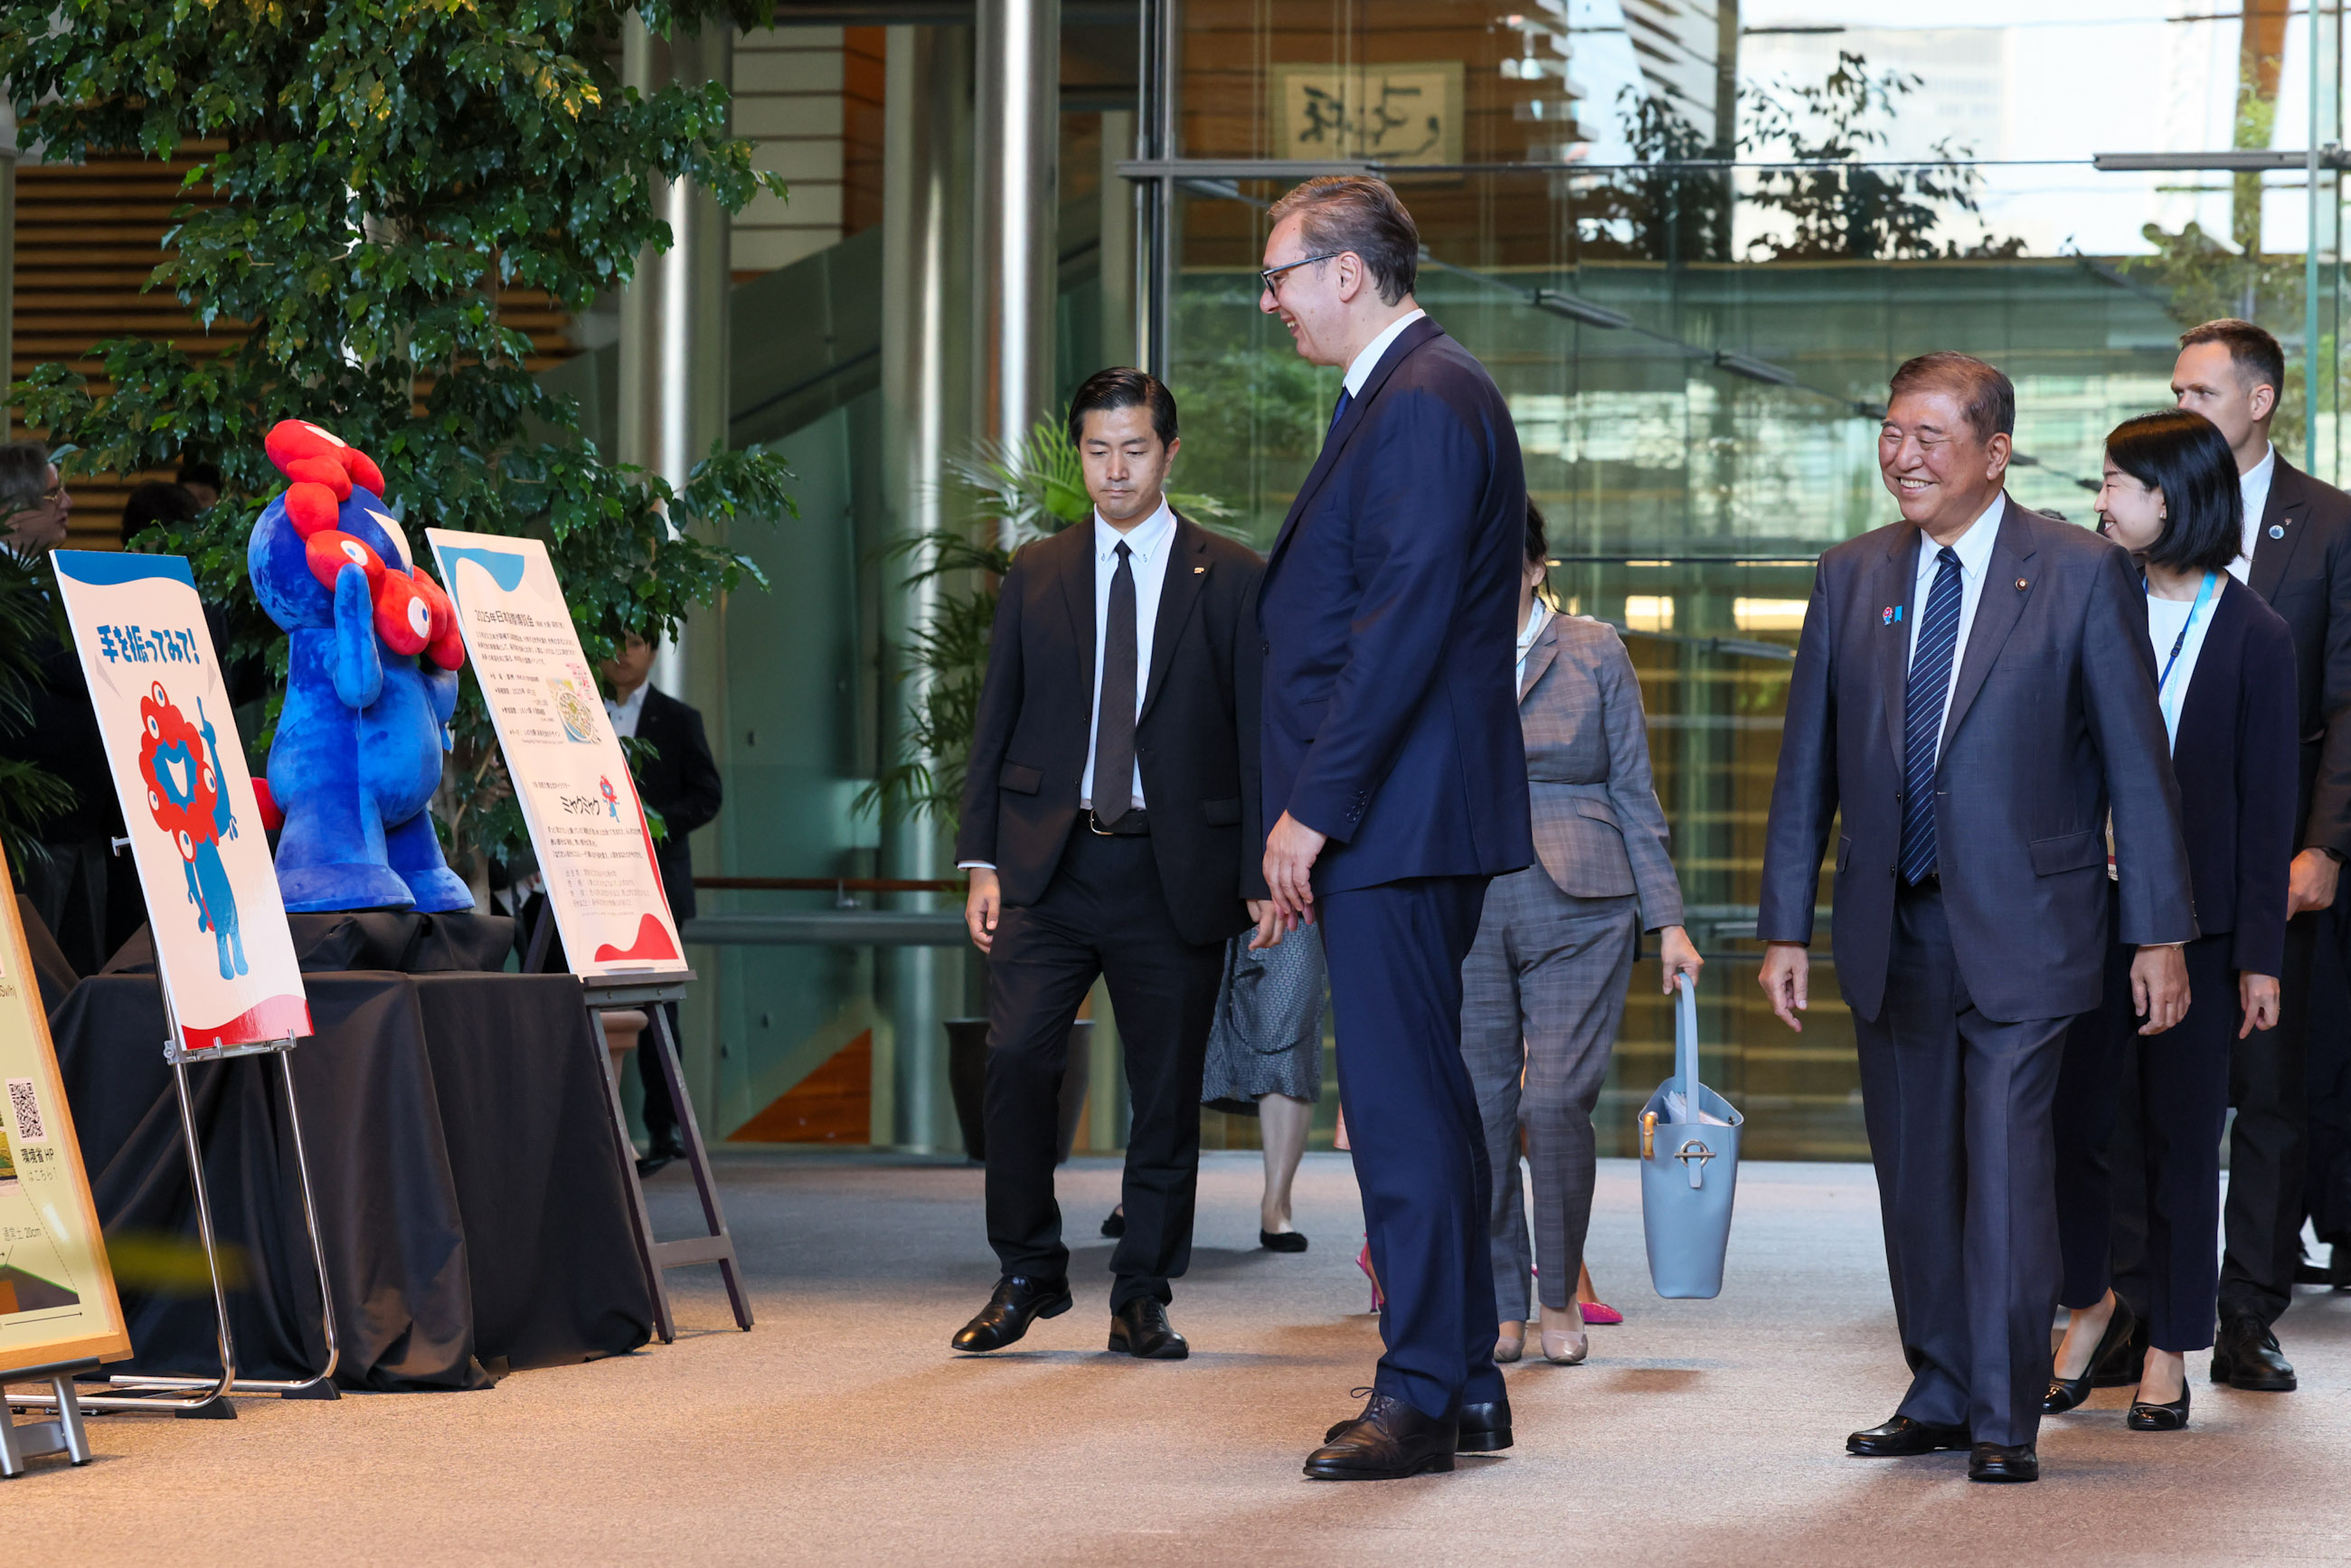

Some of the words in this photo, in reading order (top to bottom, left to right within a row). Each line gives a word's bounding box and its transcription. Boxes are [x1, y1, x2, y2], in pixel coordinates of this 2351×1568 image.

[560, 796, 600, 816] ミャクミャク
[20, 1147, 44, 1164] 環境省
[44, 1148, 54, 1161] HP
